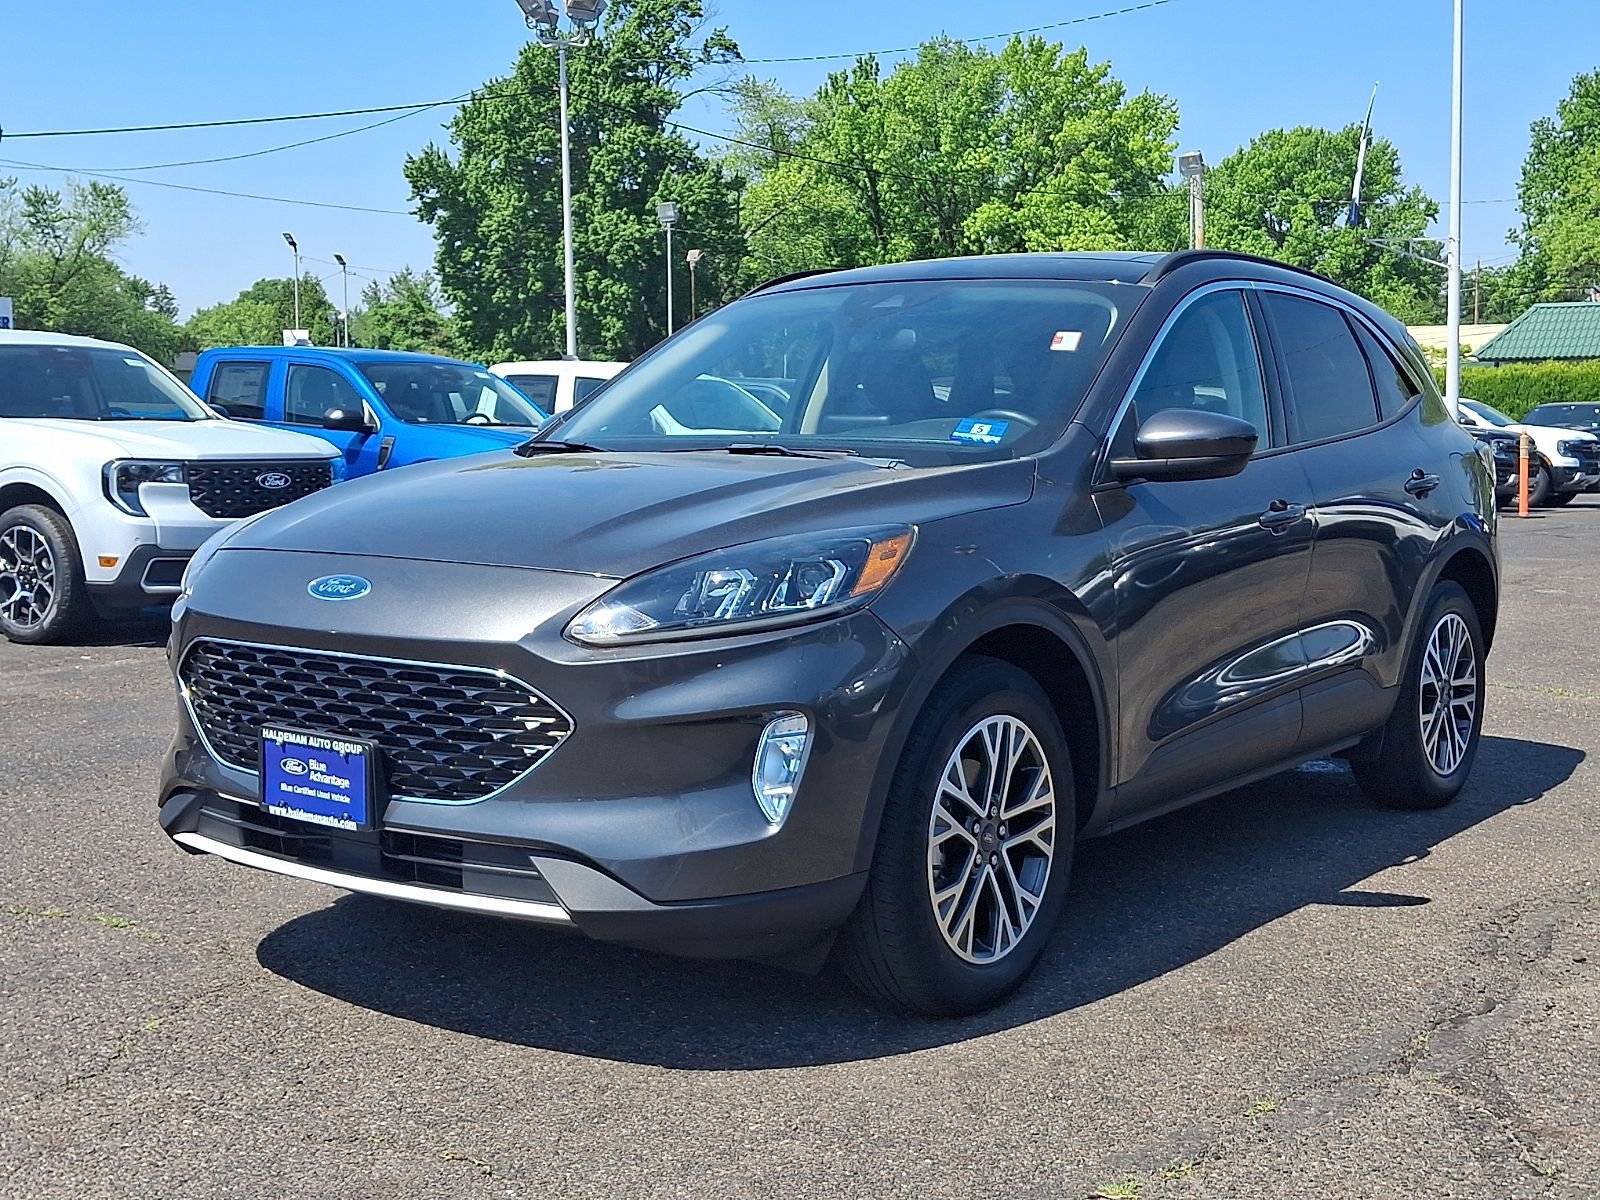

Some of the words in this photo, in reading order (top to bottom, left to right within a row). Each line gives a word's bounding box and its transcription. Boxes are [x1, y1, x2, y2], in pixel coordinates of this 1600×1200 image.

[976, 425, 985, 433] 5
[262, 729, 308, 745] HALDEMAN
[308, 737, 331, 749] AUTO
[332, 741, 363, 754] GROUP
[308, 759, 327, 772] Blue
[309, 771, 350, 789] Advantage
[280, 783, 293, 792] Blue
[294, 785, 316, 797] Certified
[317, 789, 330, 799] Used
[331, 792, 351, 804] Vehicle
[268, 805, 358, 831] www.haldemanauto.com
